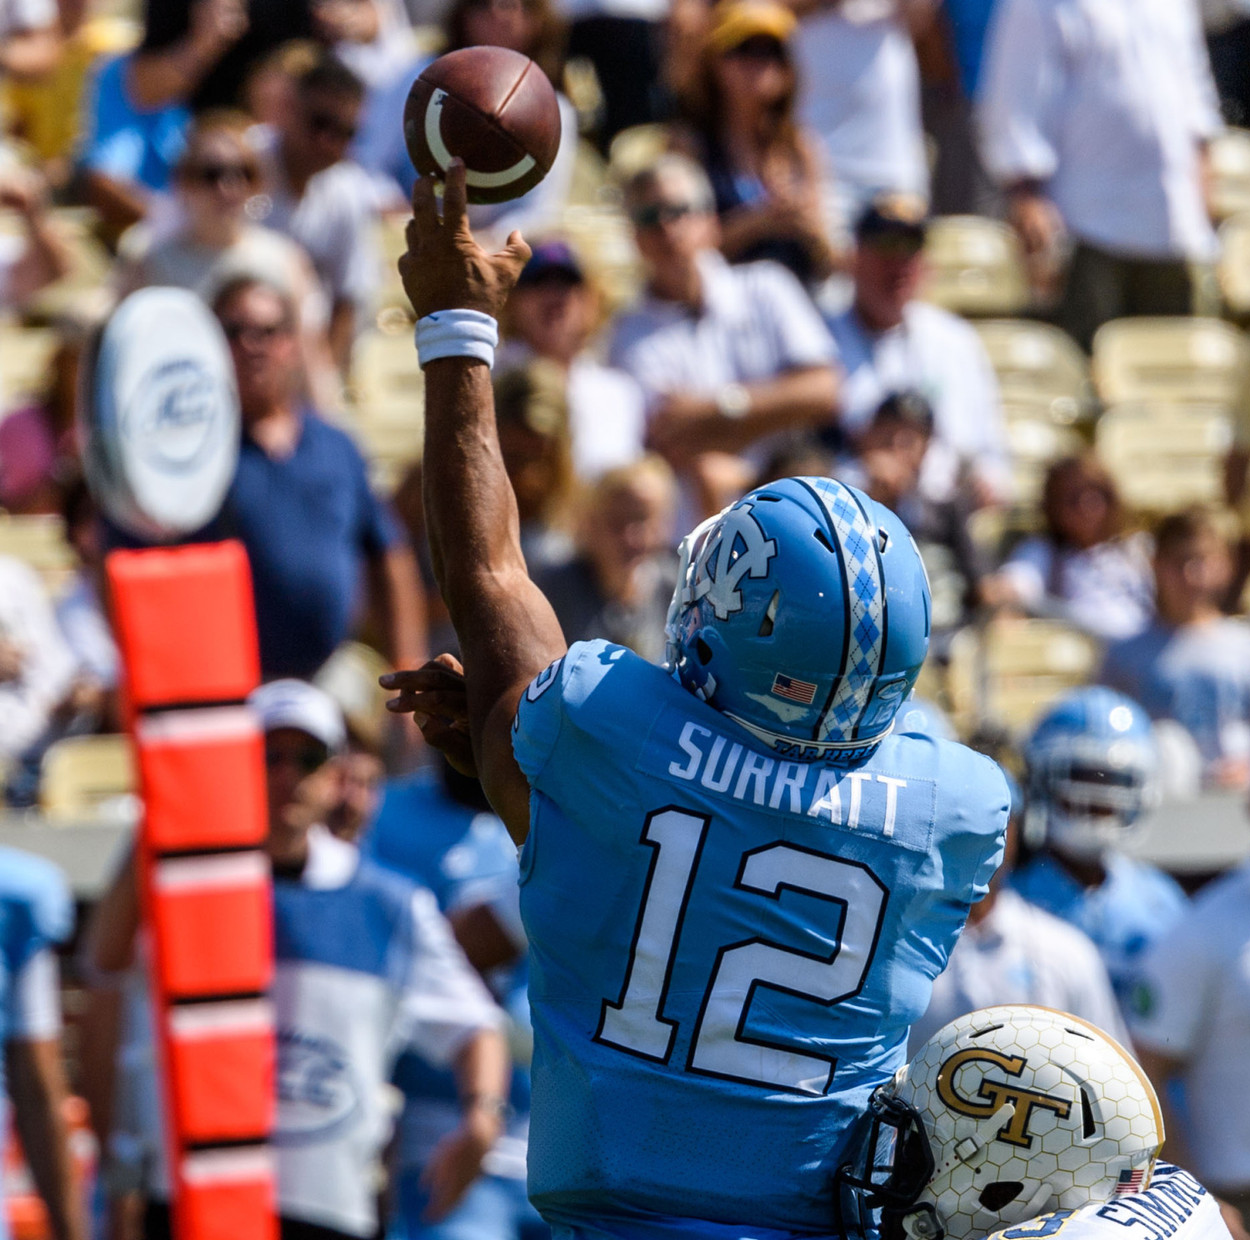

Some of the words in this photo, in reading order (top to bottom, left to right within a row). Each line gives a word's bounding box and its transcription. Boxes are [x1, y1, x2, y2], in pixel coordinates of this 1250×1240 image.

[668, 721, 908, 838] SURRATT
[773, 739, 820, 761] TAR
[592, 804, 890, 1097] 12
[935, 1046, 1073, 1150] GT
